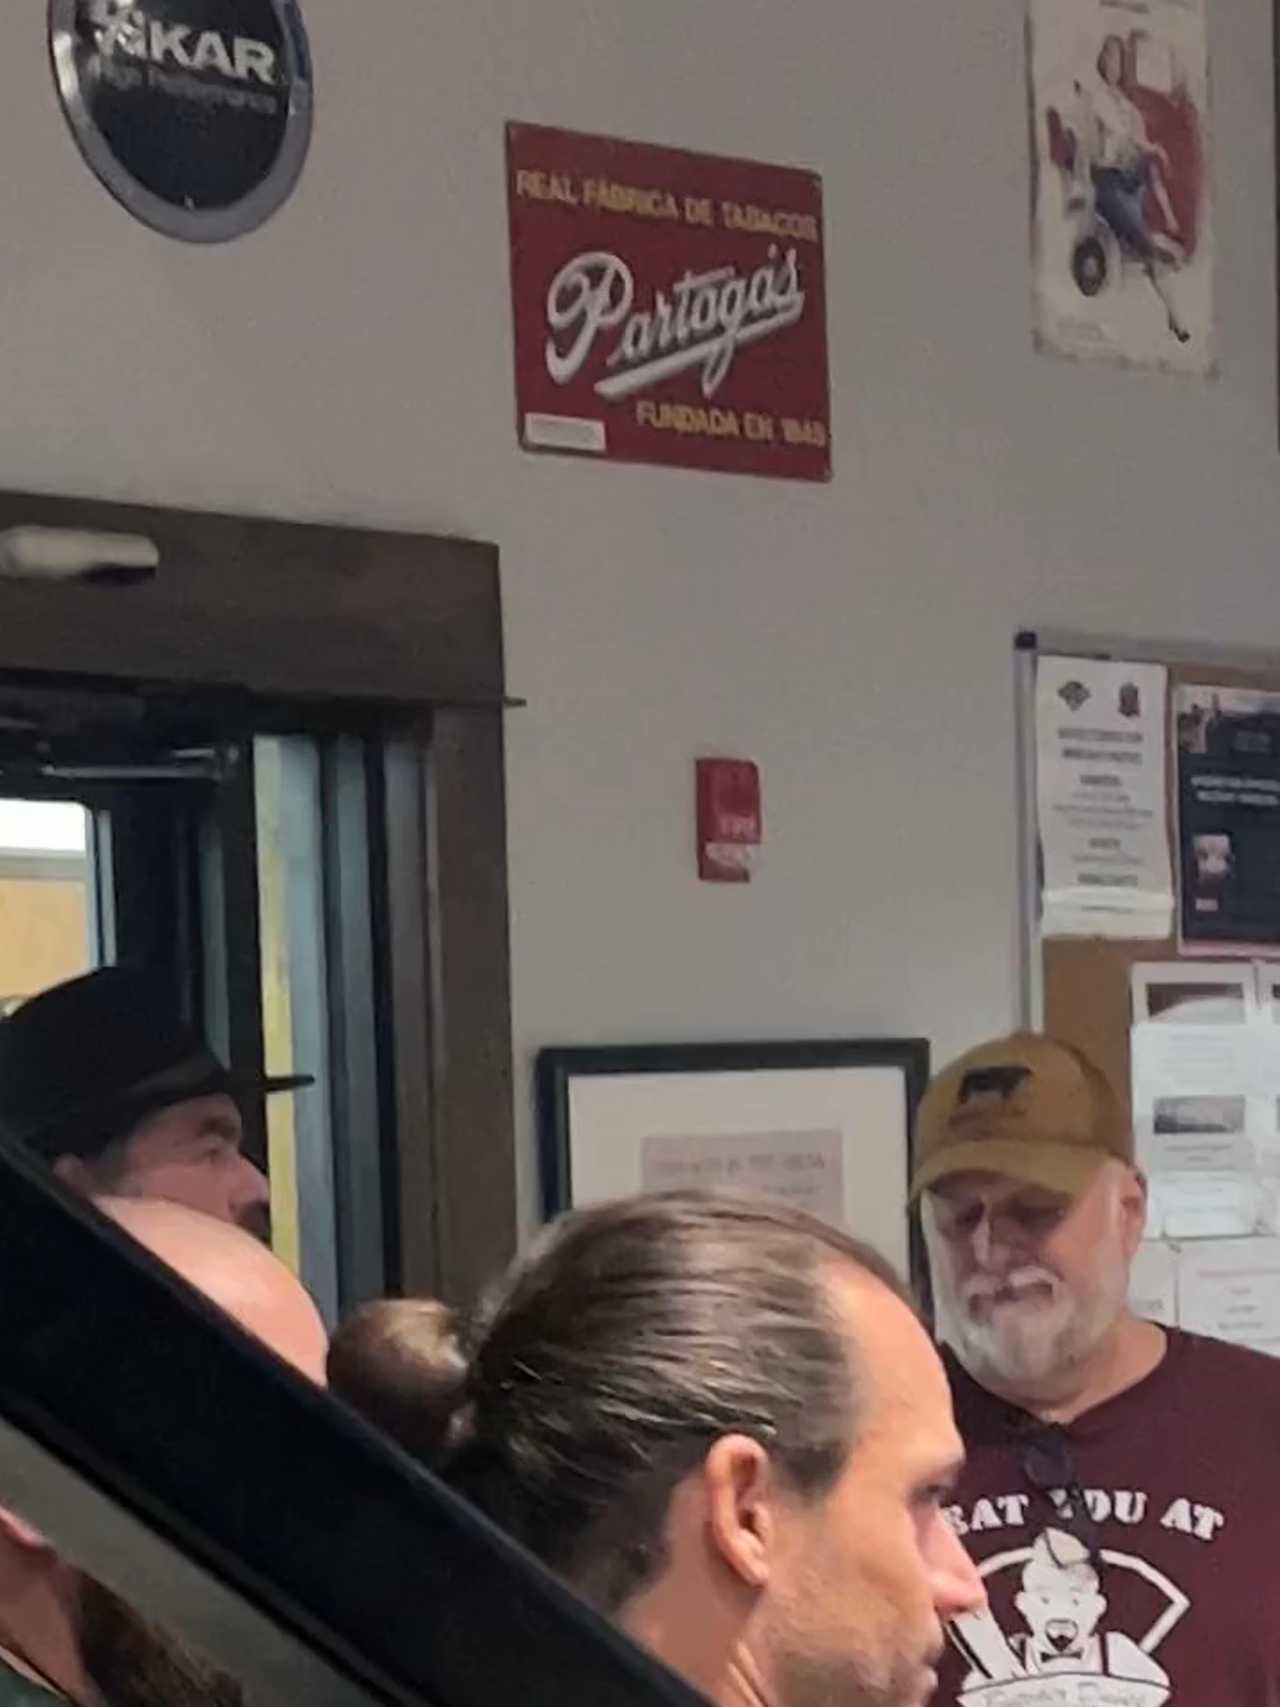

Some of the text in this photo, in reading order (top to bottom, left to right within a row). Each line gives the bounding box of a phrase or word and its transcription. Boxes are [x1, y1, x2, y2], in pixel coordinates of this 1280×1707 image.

[516, 169, 577, 205] REAL
[685, 197, 713, 225] DE
[722, 200, 819, 242] TABACOS
[635, 399, 740, 437] FUNDADA
[744, 411, 774, 442] EN
[942, 1494, 1029, 1536] EAT
[1159, 1497, 1225, 1542] AT
